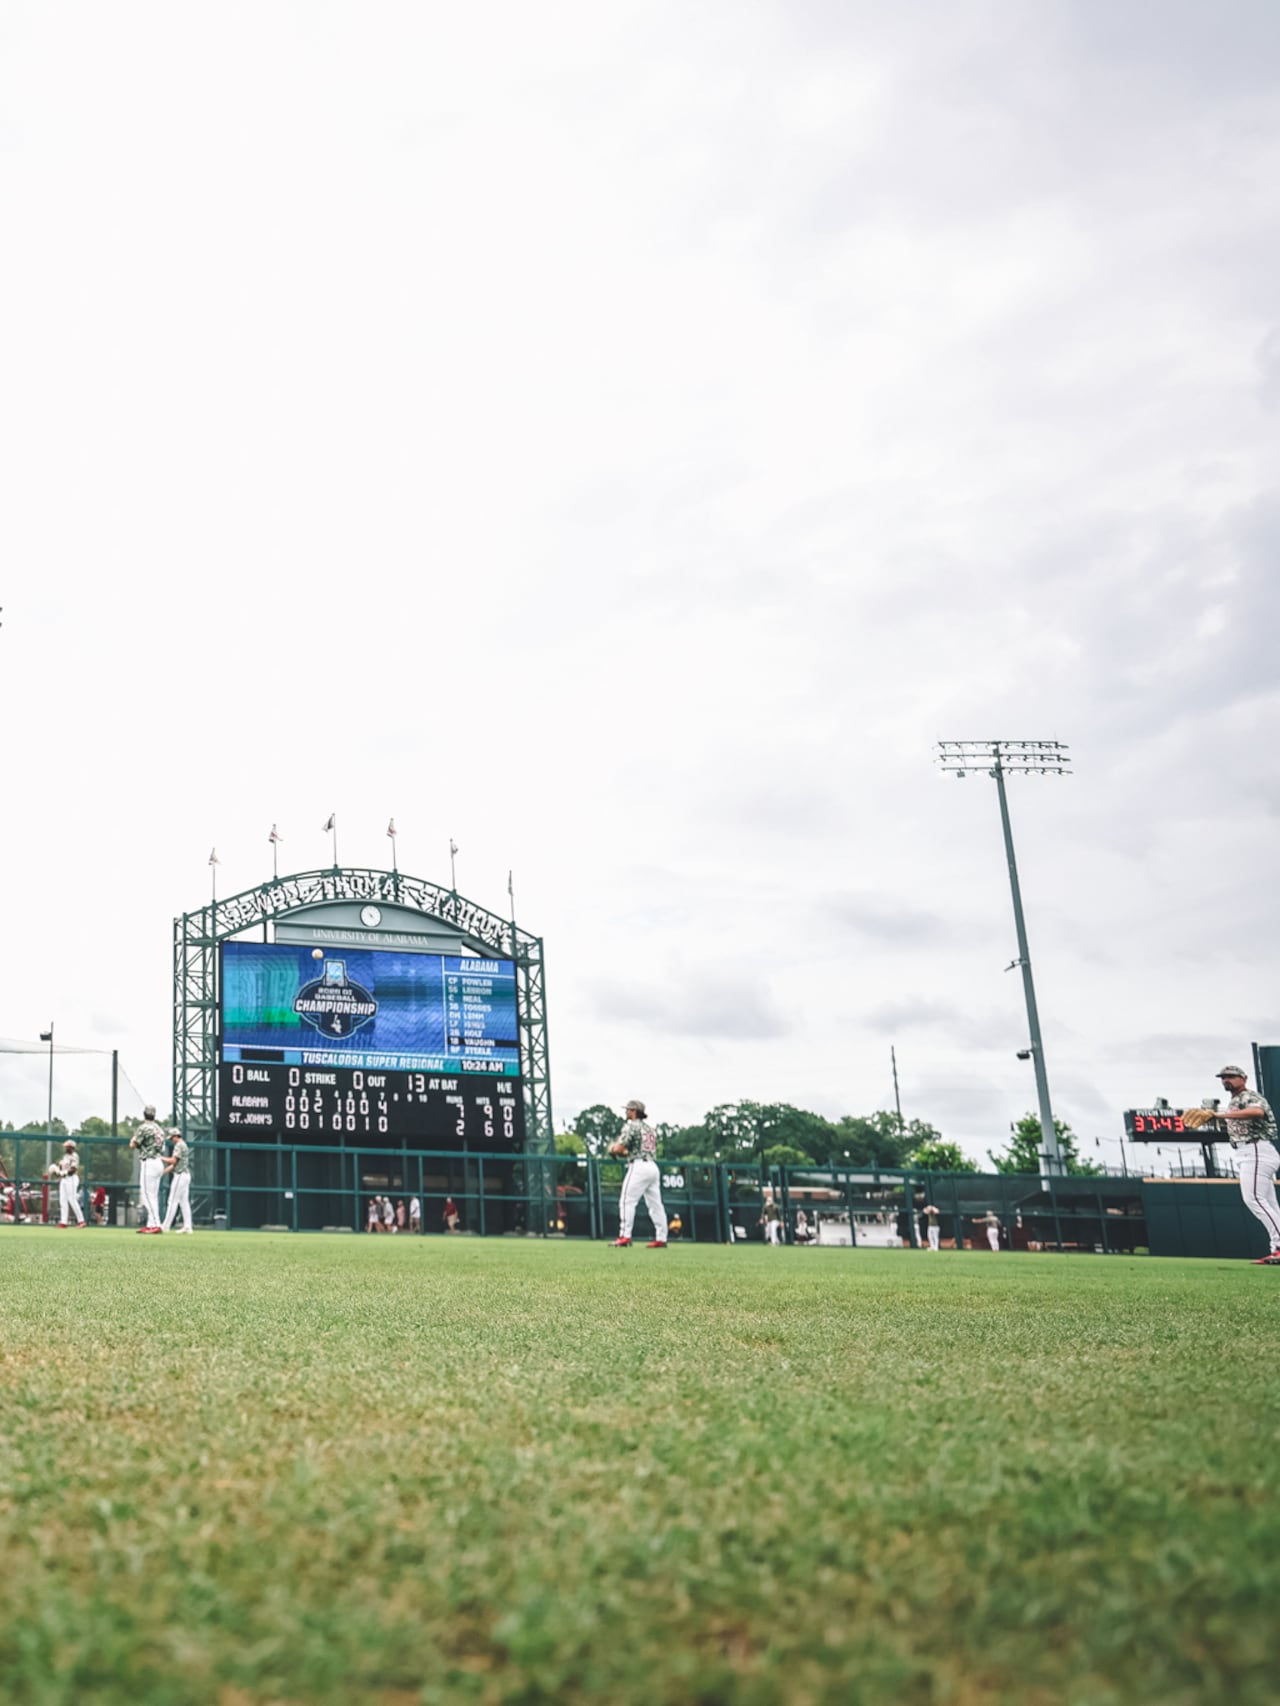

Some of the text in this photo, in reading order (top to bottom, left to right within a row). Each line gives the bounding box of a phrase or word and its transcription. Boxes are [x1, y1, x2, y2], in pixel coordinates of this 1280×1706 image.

[312, 929, 429, 946] UNIVERSITY OF ALABAMA
[460, 959, 499, 974] ALABAMA
[296, 999, 376, 1015] CHAMPIONSHIP
[303, 1052, 444, 1070] TUSCALOOSA SUPER REGIONAL
[462, 1060, 504, 1073] 10:24 AM
[232, 1065, 512, 1094] 0 BALL 0 STRIKE 0 OUT 13 AT BAT H/E
[232, 1095, 513, 1121] ALABAMA 0 0 2 1 0 0 4 7 9 0
[286, 1112, 295, 1128] 0
[300, 1113, 309, 1129] 0
[319, 1114, 323, 1128] 1
[333, 1114, 341, 1130] 0
[346, 1115, 355, 1131] 0
[365, 1117, 369, 1131] 1
[378, 1116, 388, 1132] 0
[456, 1119, 464, 1136] 2
[484, 1121, 493, 1137] 6
[504, 1122, 513, 1138] 0
[662, 1174, 684, 1188] 360
